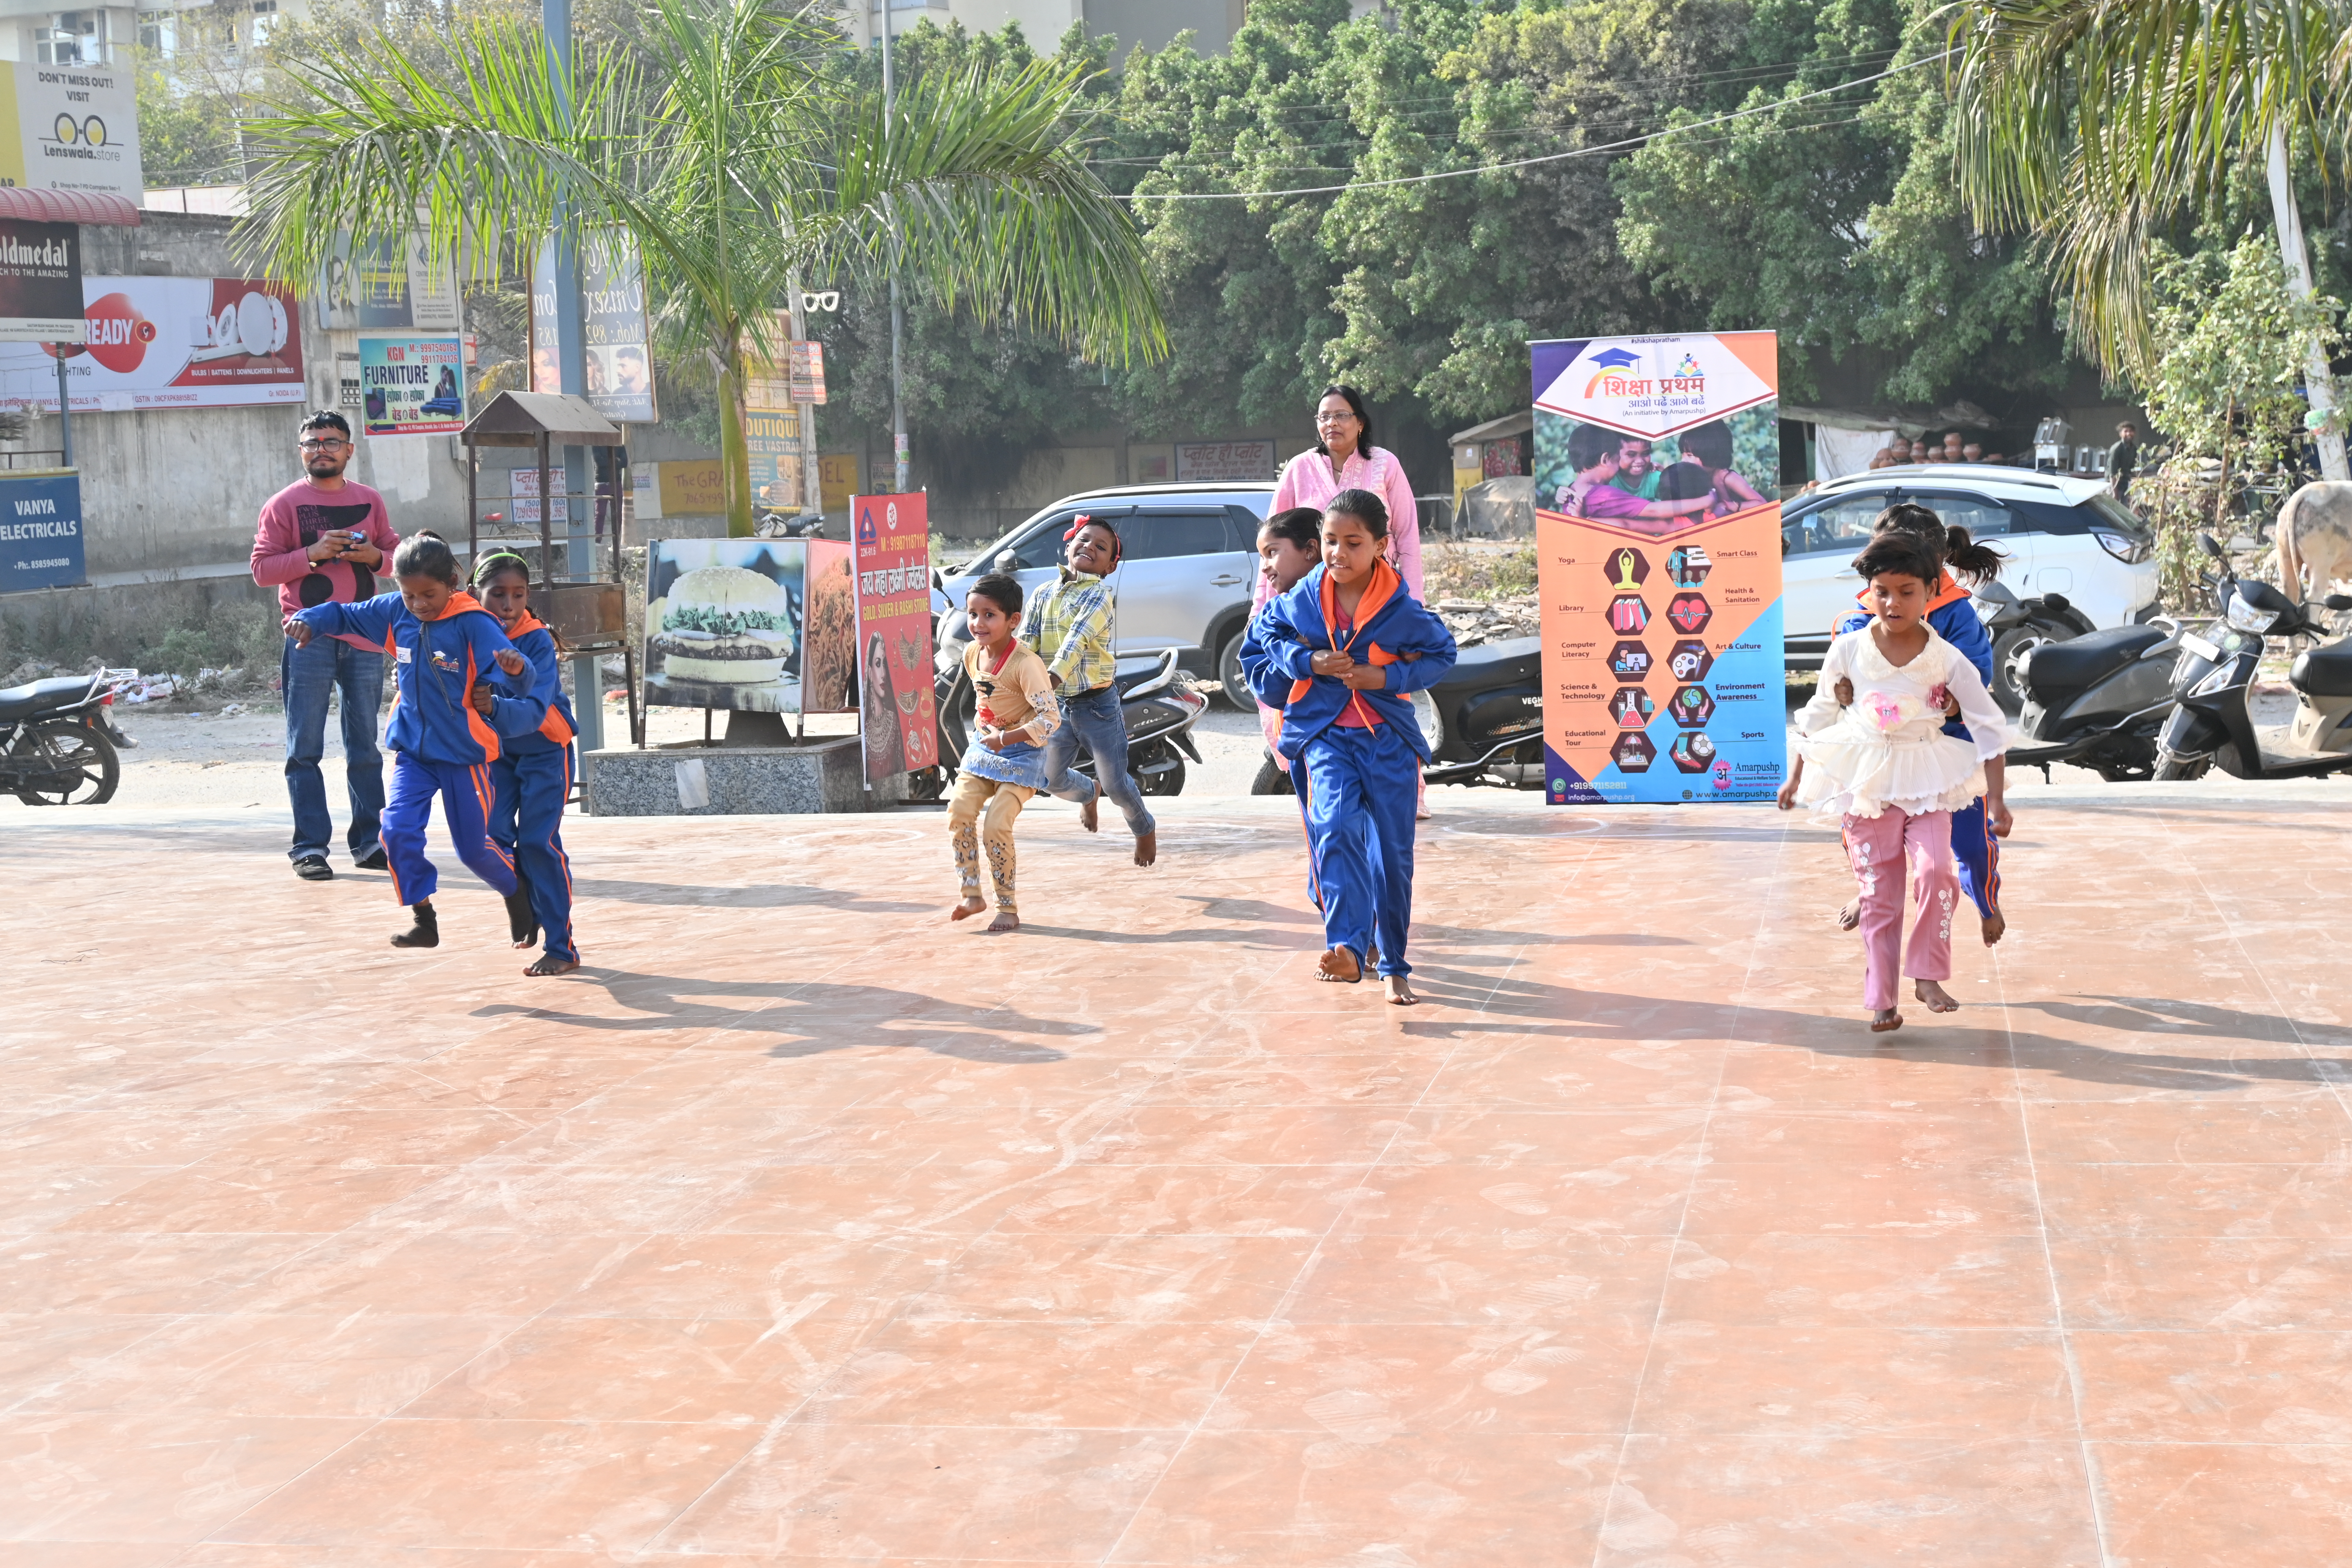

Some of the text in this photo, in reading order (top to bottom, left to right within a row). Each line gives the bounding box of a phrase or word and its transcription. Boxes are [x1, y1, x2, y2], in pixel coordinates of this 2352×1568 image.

[38, 71, 114, 88] DON'T MISS OUT!
[66, 90, 90, 102] VISIT
[44, 144, 120, 161] Lenswala.store
[0, 235, 68, 267] ldmedal
[11, 268, 20, 277] TO
[22, 268, 35, 277] THE
[38, 270, 69, 278] AMAZING
[387, 346, 405, 362] KGN
[420, 343, 457, 352] 9997540164
[421, 354, 458, 364] 9911784126
[52, 366, 91, 377] LIHTING
[364, 365, 429, 385] FURNITURE
[1603, 376, 1705, 397] शिक्षा प्रथम
[386, 387, 402, 403] सोफा
[409, 387, 425, 402] सोफा
[54, 397, 89, 406] ELTRICALS
[1628, 396, 1651, 408] आओ
[1669, 395, 1689, 406] आगे
[746, 417, 800, 439] OUTIQUE
[748, 440, 763, 451] REE
[1183, 443, 1264, 461] प्लॉट ही प्लॉट
[298, 505, 317, 514] TWO
[515, 506, 541, 519] 7291919
[298, 511, 319, 520] PLUS
[300, 516, 328, 526] THREE
[301, 523, 335, 533] EQUALS
[890, 533, 926, 550] 919871187110
[1558, 556, 1575, 565] Yoga
[860, 571, 874, 597] जय
[874, 569, 887, 597] महा
[888, 556, 906, 594] लक्ष्मी
[863, 596, 928, 622] GOLD, SILVER & RASHI STONE
[1559, 604, 1584, 612] Library
[1715, 683, 1765, 691] Environment
[1522, 696, 1543, 705] VEGH
[1560, 692, 1606, 700] Technology
[1741, 731, 1765, 739] Sports
[1735, 761, 1780, 774] Amarpushp
[1570, 781, 1627, 790] +919971152811
[1568, 794, 1635, 802] info@amarpushp.org
[1696, 790, 1778, 799] www.amarpushp.o
